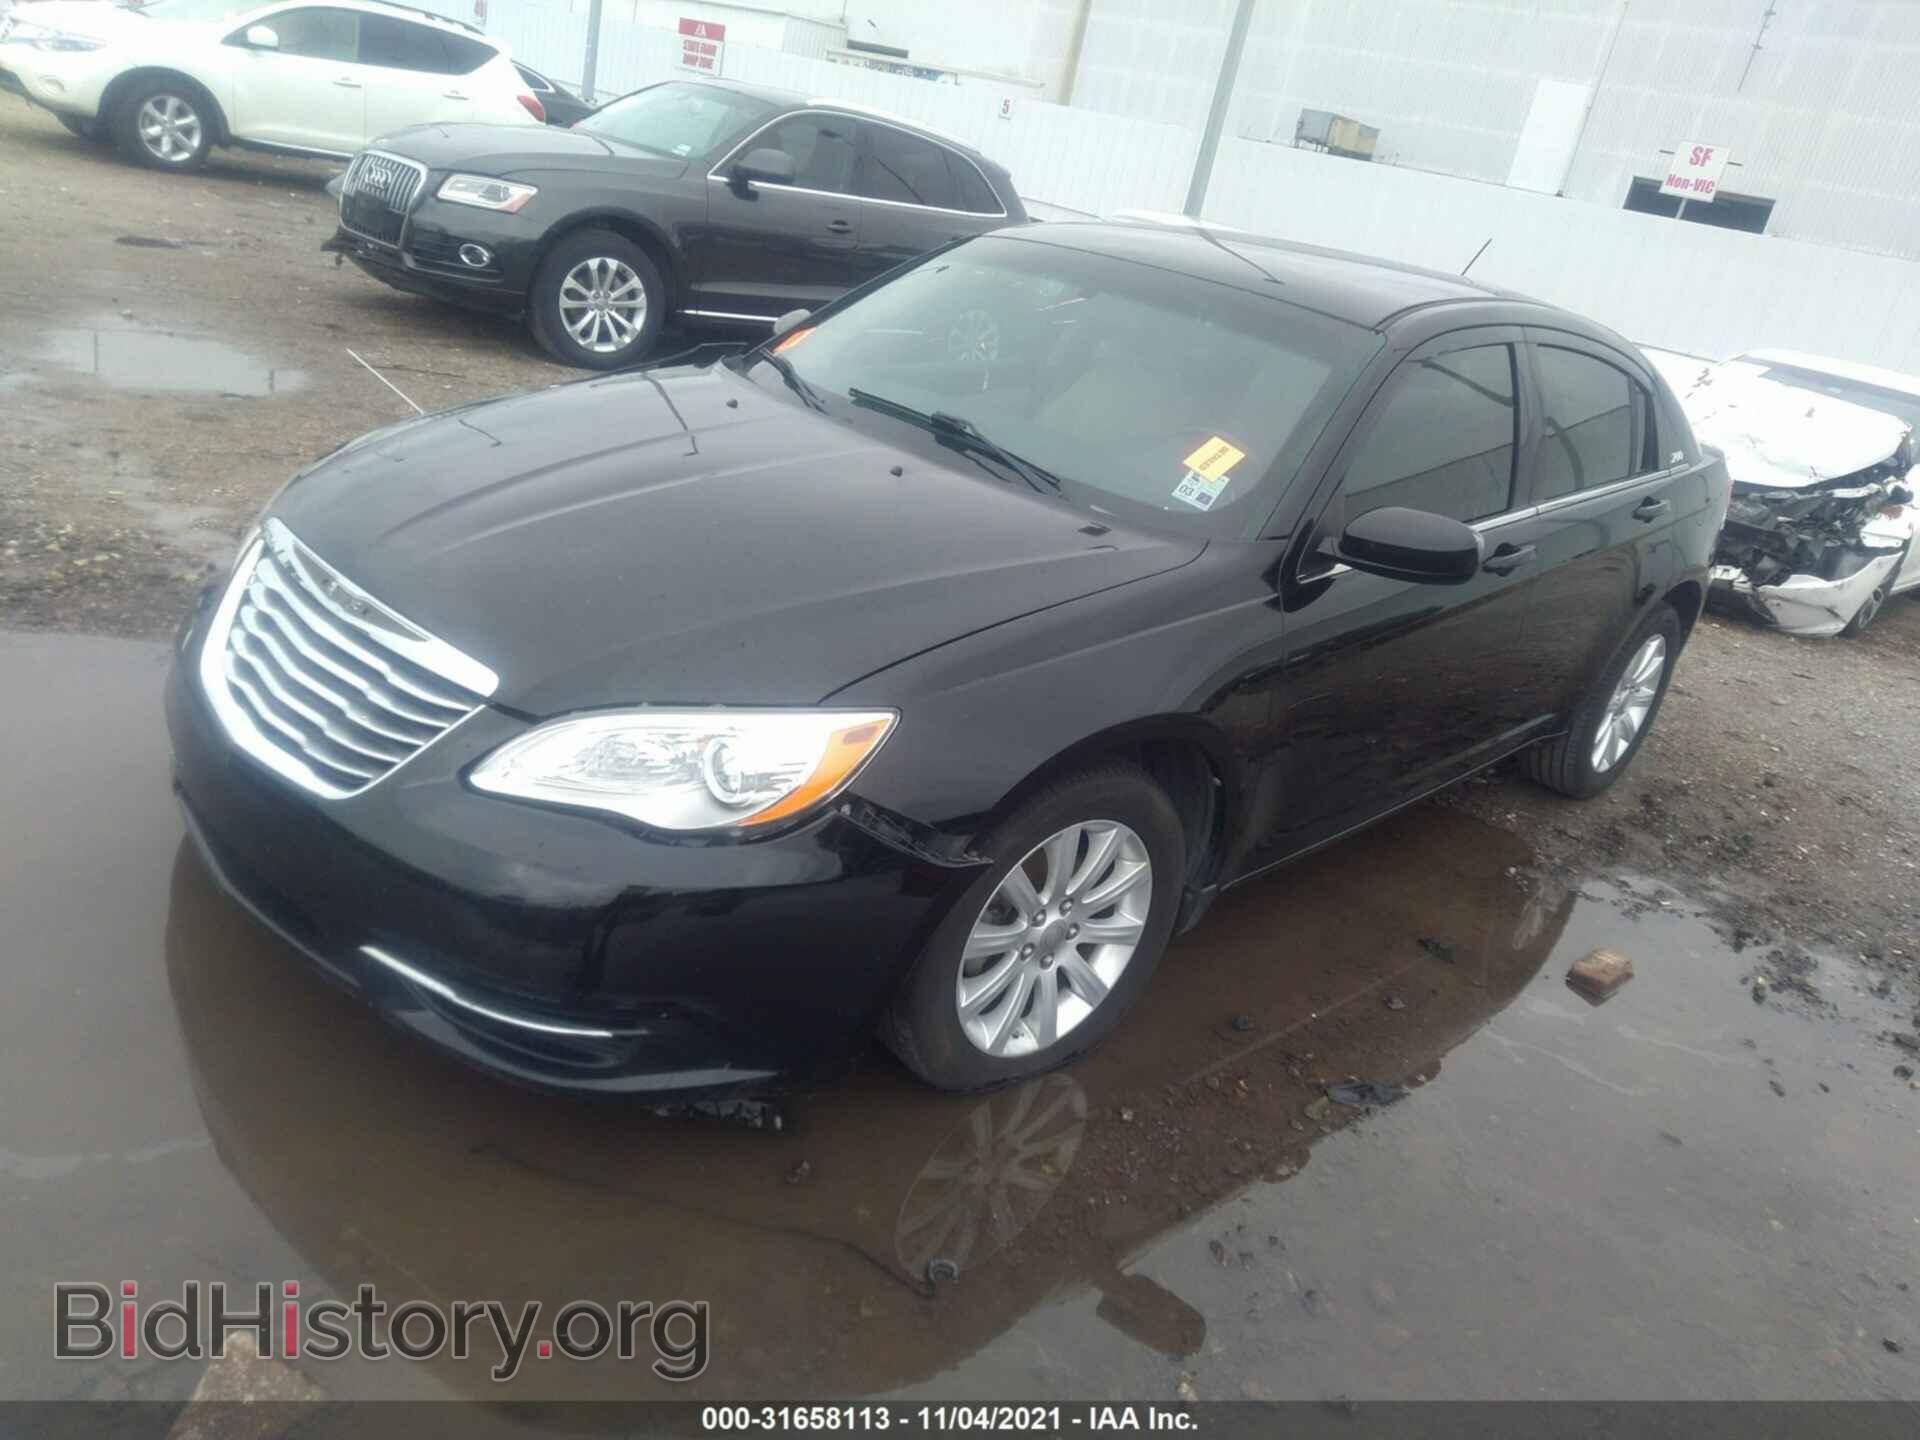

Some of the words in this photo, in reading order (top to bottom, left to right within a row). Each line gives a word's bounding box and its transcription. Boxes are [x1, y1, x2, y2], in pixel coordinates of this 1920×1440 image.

[1002, 99, 1010, 114] 5
[1689, 146, 1714, 167] SF
[1665, 174, 1715, 194] Non-VIC
